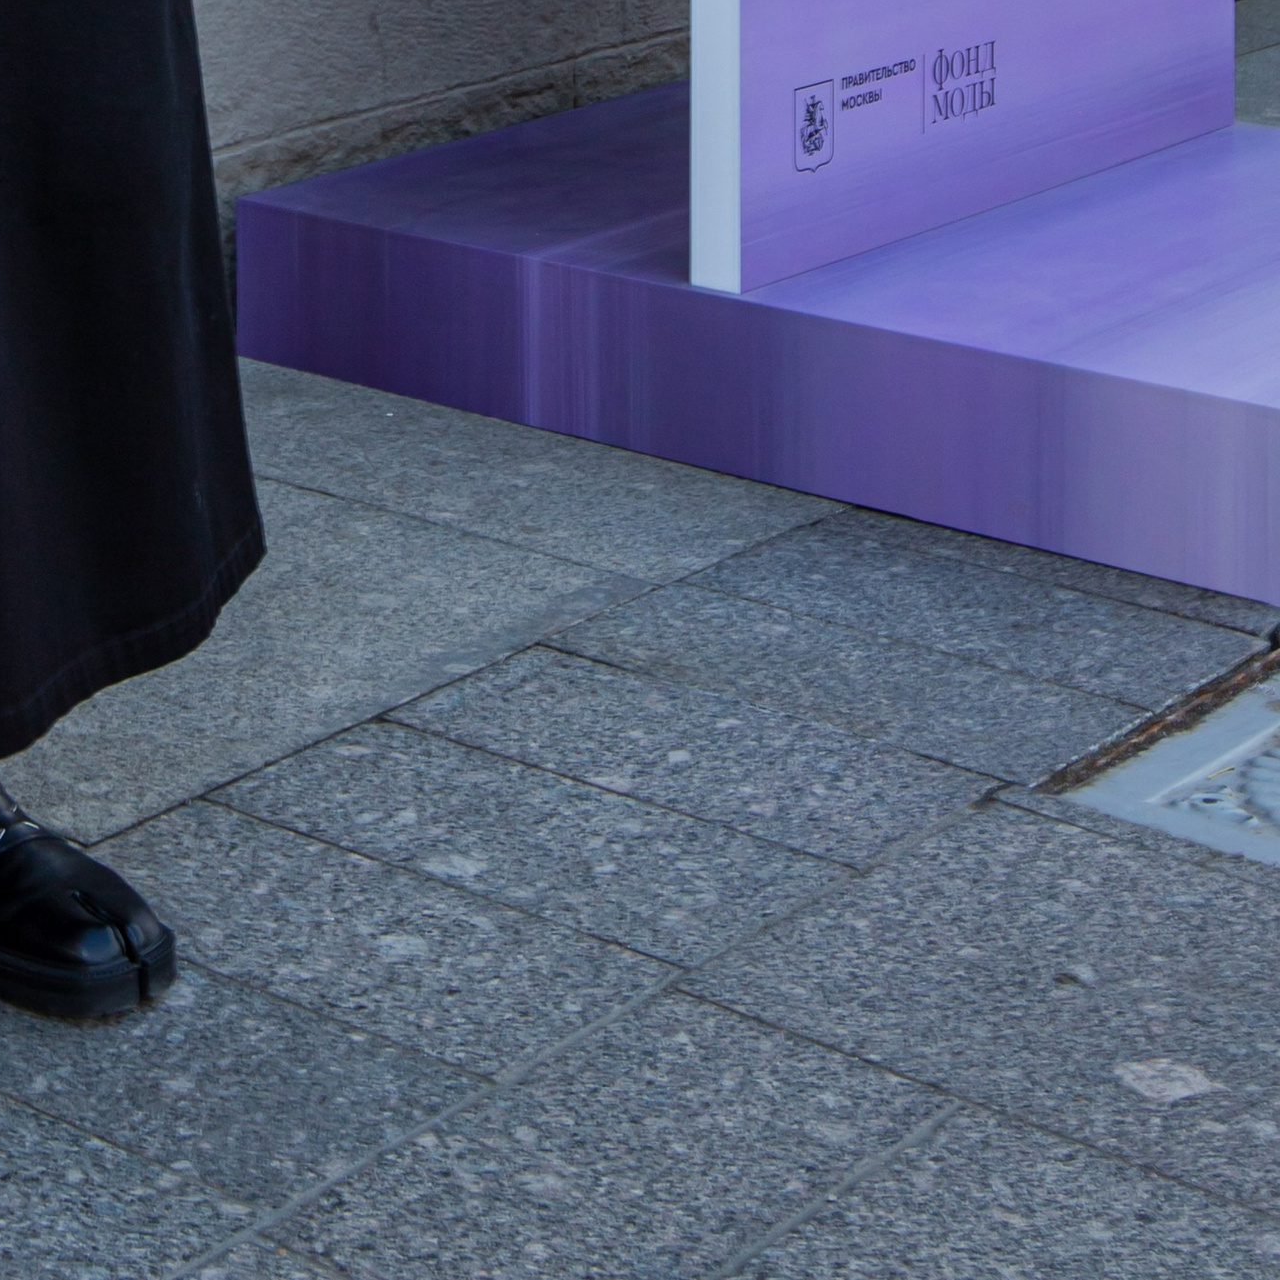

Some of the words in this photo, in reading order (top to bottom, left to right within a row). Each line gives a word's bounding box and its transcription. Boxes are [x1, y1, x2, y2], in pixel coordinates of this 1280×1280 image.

[840, 57, 917, 91] ПРАВИТЕЛЬСТВО
[931, 39, 997, 93] ФОНД
[840, 87, 883, 112] МОСКВЫ
[931, 76, 997, 125] МОДЫ
